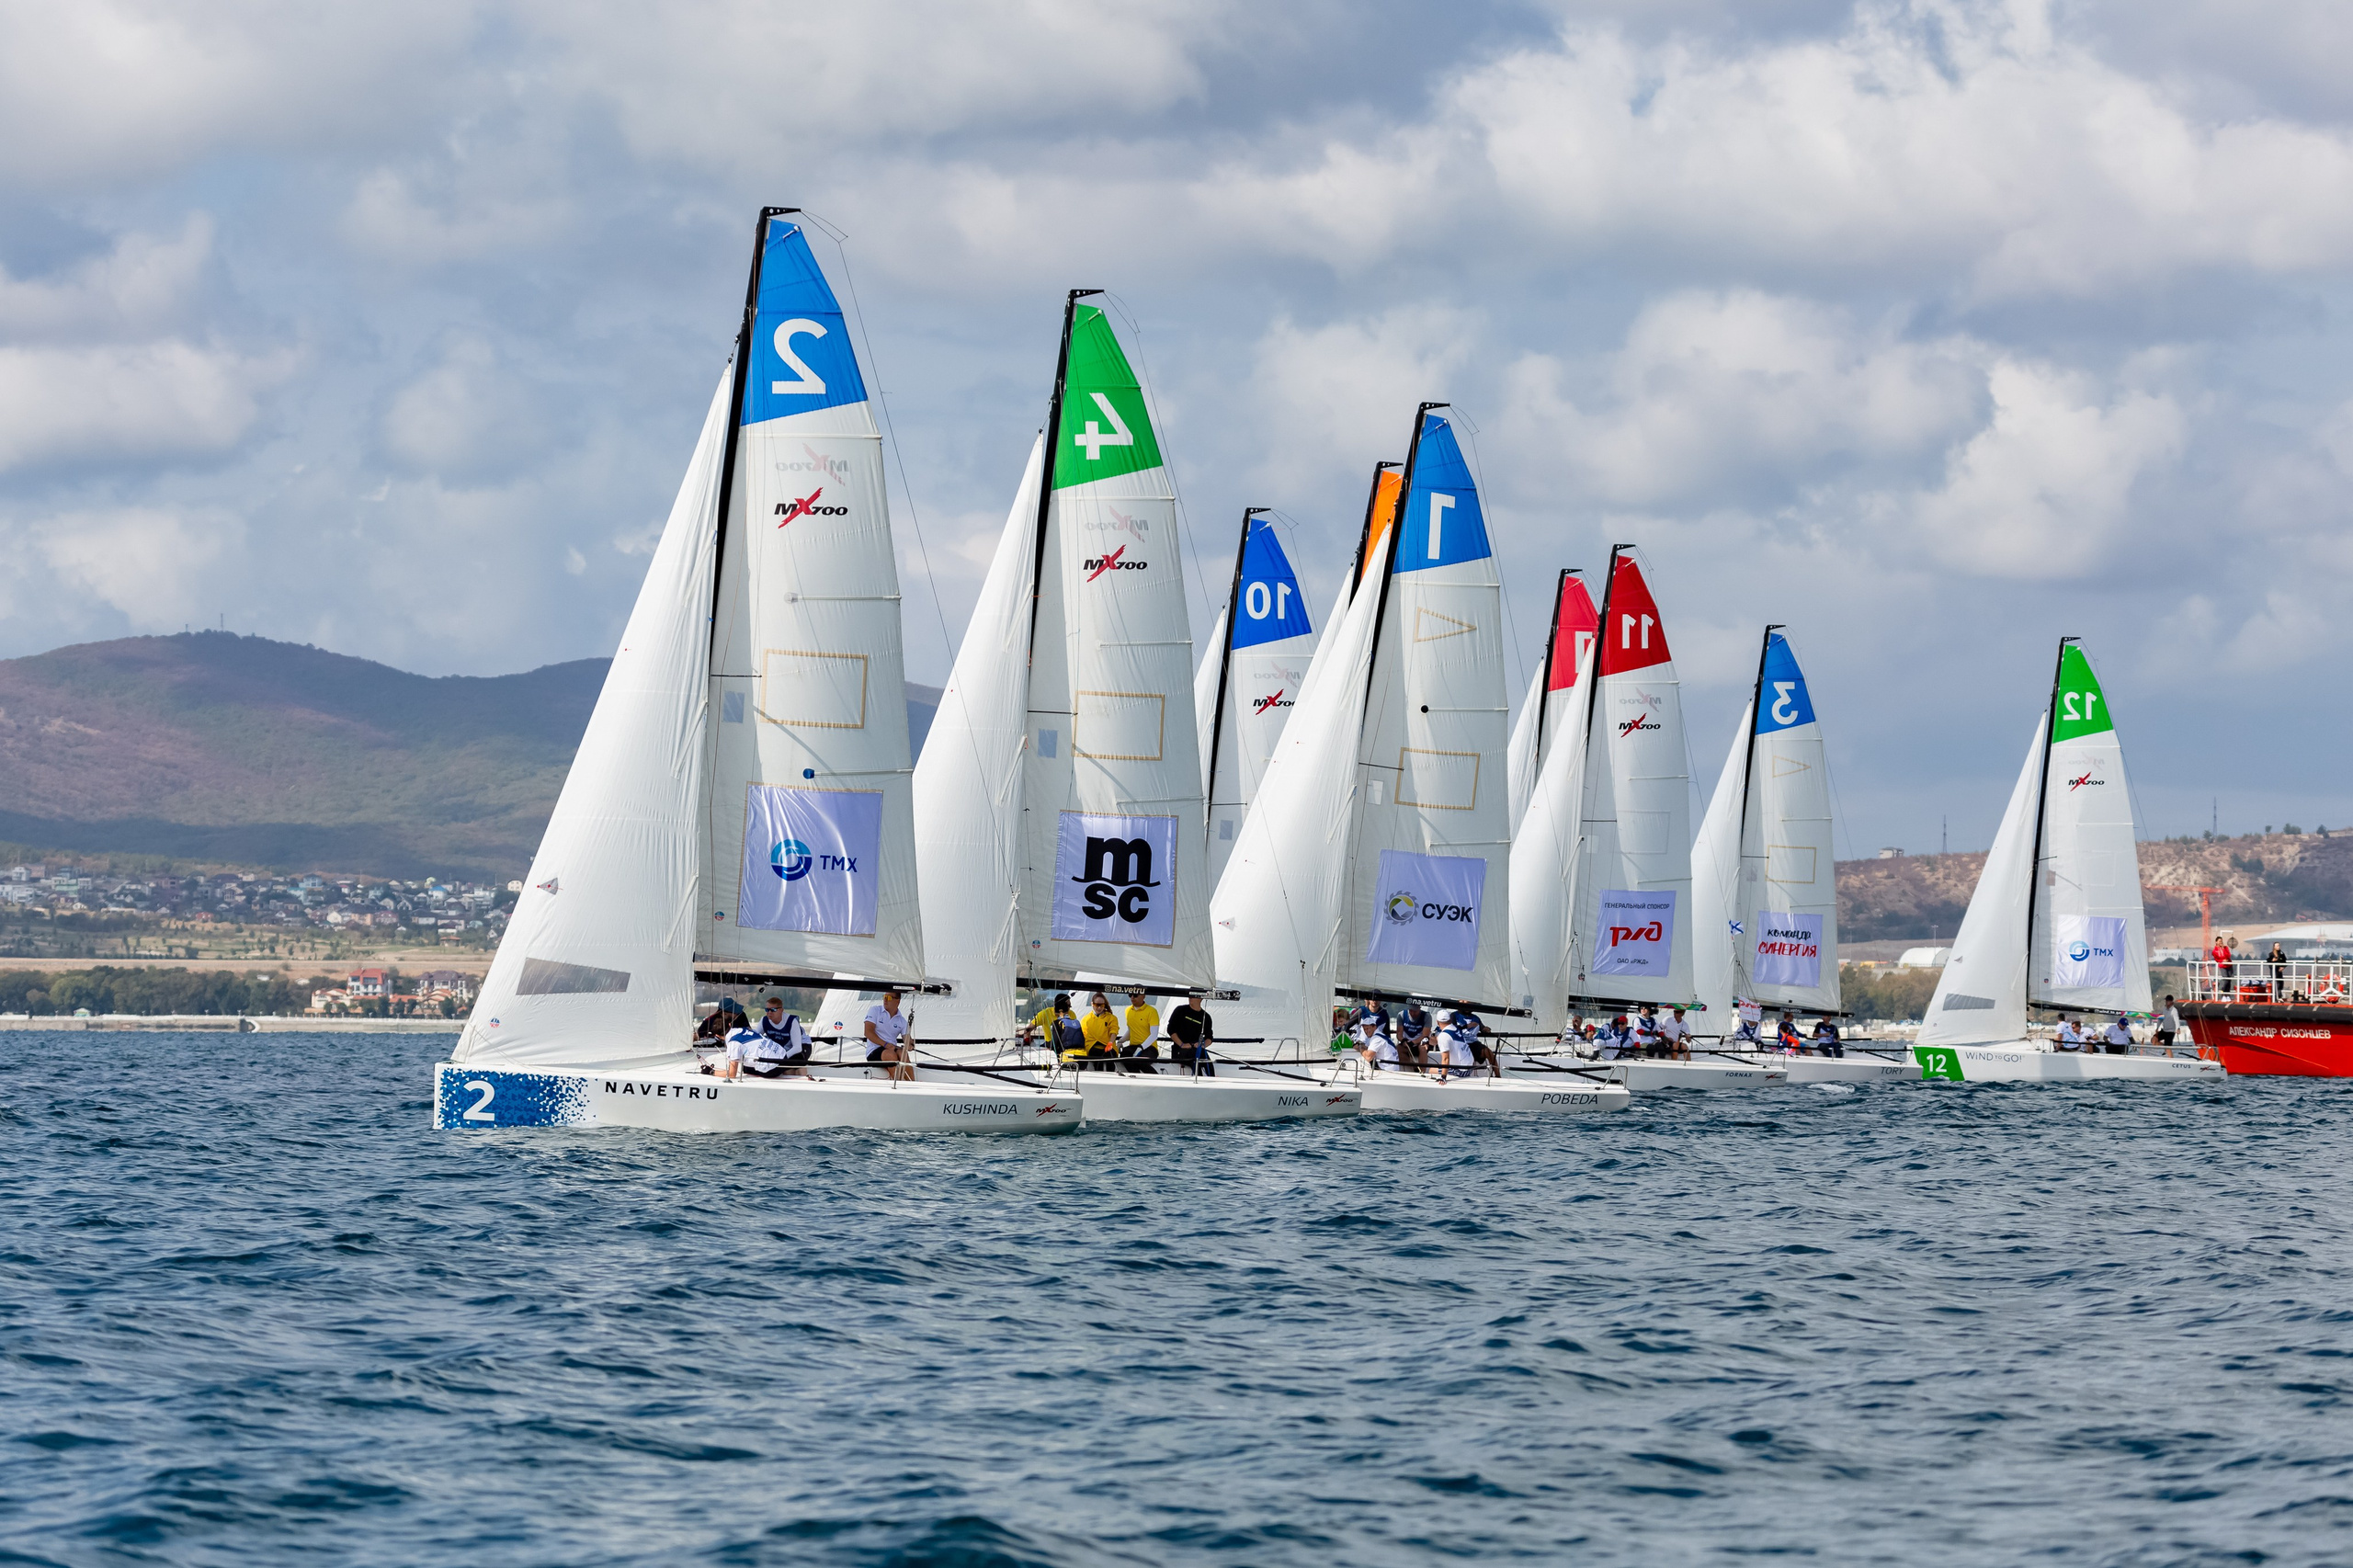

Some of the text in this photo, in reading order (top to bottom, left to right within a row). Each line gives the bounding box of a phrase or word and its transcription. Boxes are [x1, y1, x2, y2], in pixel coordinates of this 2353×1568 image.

[774, 487, 848, 528] MX700
[1083, 544, 1148, 583] MX700
[1619, 712, 1661, 738] MX700
[2068, 771, 2105, 792] MX700
[820, 855, 858, 872] TMX
[1422, 903, 1473, 923] СУЭК
[1758, 941, 1817, 958] СИНЕРГИЯ
[2093, 948, 2114, 957] TMX
[2229, 1026, 2332, 1040] АЛЕКСАНДР СИЗОНЦЕВ
[1926, 1054, 1947, 1073] 12
[605, 1081, 720, 1100] NAVETRU
[1540, 1093, 1598, 1105] POBEDA
[462, 1080, 495, 1121] 2
[943, 1103, 1017, 1115] KUSHINDA
[1278, 1096, 1309, 1107] NIKA
